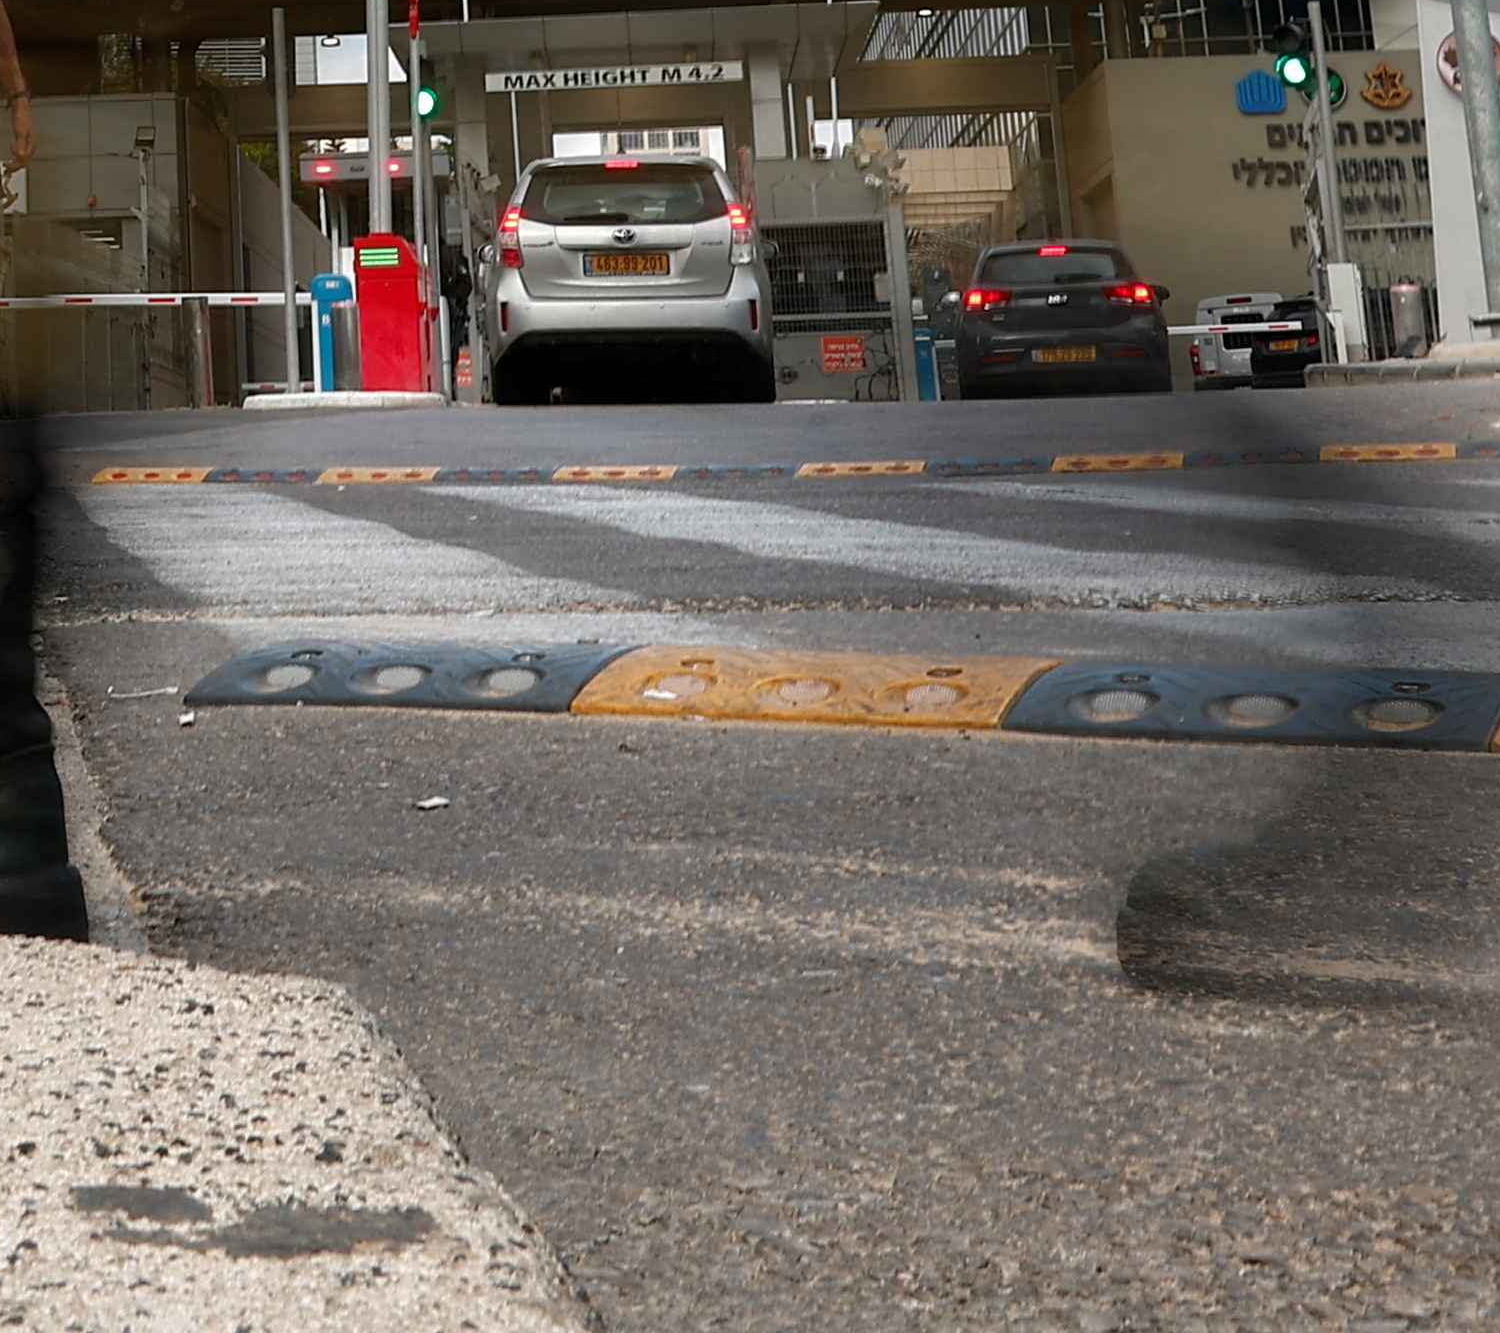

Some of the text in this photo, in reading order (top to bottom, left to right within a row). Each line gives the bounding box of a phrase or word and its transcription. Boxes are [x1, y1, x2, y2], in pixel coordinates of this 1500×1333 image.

[504, 72, 557, 91] MAX
[563, 68, 651, 87] HEIGHT
[661, 65, 682, 83] M
